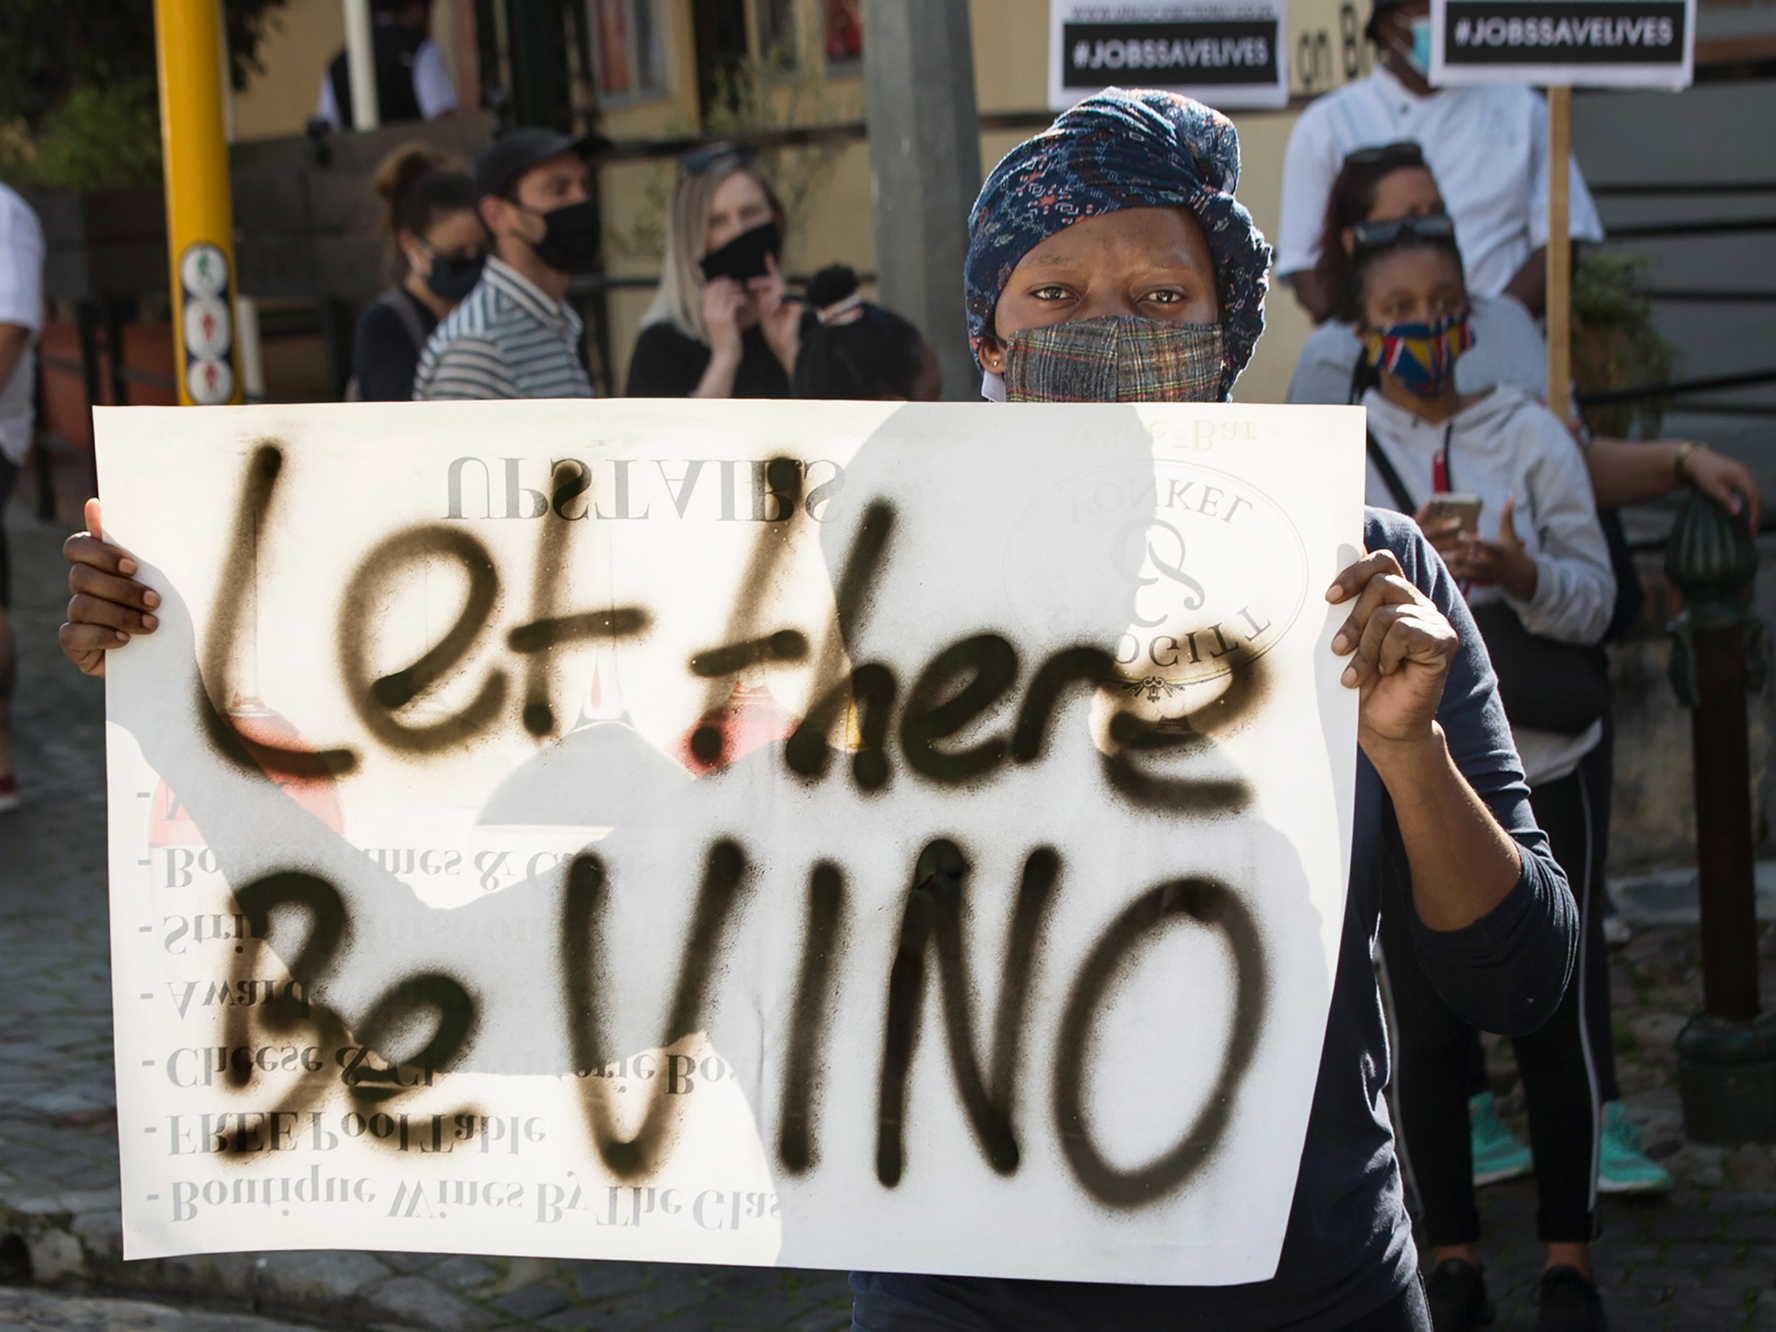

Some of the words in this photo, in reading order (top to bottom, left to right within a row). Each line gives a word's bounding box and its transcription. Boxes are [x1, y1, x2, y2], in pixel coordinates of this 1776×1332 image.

[1073, 36, 1269, 69] #JOBSSAVELIVES
[1454, 15, 1675, 47] #JOBSSAVELIVES
[200, 439, 650, 779] Let
[690, 456, 1268, 813] there
[217, 867, 483, 1158] Be
[560, 836, 1268, 1209] VINO
